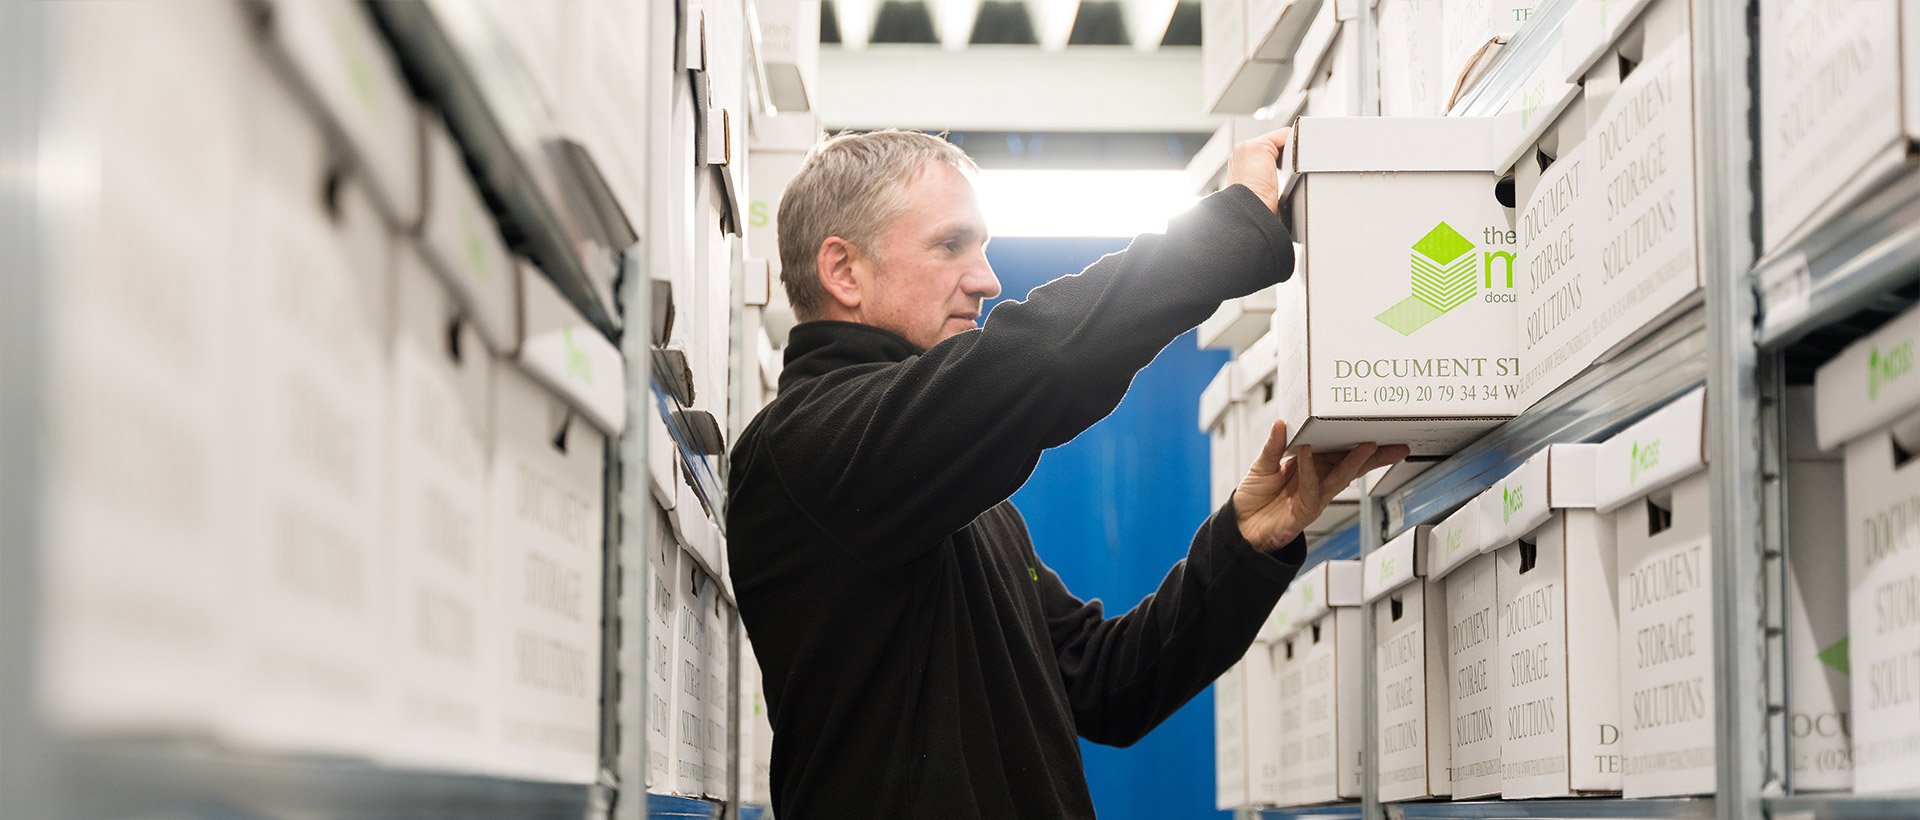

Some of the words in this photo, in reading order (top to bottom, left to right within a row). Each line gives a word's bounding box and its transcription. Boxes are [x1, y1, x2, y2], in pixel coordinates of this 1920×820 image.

[1598, 61, 1673, 173] DOCUMENT
[1607, 133, 1668, 222] STORAGE
[1524, 160, 1581, 250] DOCUMENT
[1483, 226, 1517, 245] the
[1530, 223, 1576, 295] STORAGE
[1601, 190, 1677, 286] SOLUTIONS
[1485, 292, 1516, 304] docu
[1526, 273, 1583, 350] SOLUTIONS
[1334, 358, 1487, 379] DOCUMENT
[1331, 386, 1367, 403] TEL:
[1374, 386, 1410, 406] (029)
[1416, 386, 1432, 402] 20
[1438, 385, 1454, 401] 79
[1460, 385, 1476, 401] 34
[1482, 384, 1498, 401] 34
[1630, 546, 1702, 611] DOCUMENT
[1453, 607, 1490, 656] DOCUMENT
[1506, 583, 1554, 638] DOCUMENT
[1511, 642, 1549, 688] STORAGE
[1637, 613, 1696, 670] STORAGE
[1458, 658, 1488, 700] STORAGE
[1634, 677, 1705, 731] SOLUTIONS
[1456, 706, 1493, 748] SOLUTIONS
[1508, 696, 1555, 741] SOLUTIONS
[1599, 723, 1623, 746] D
